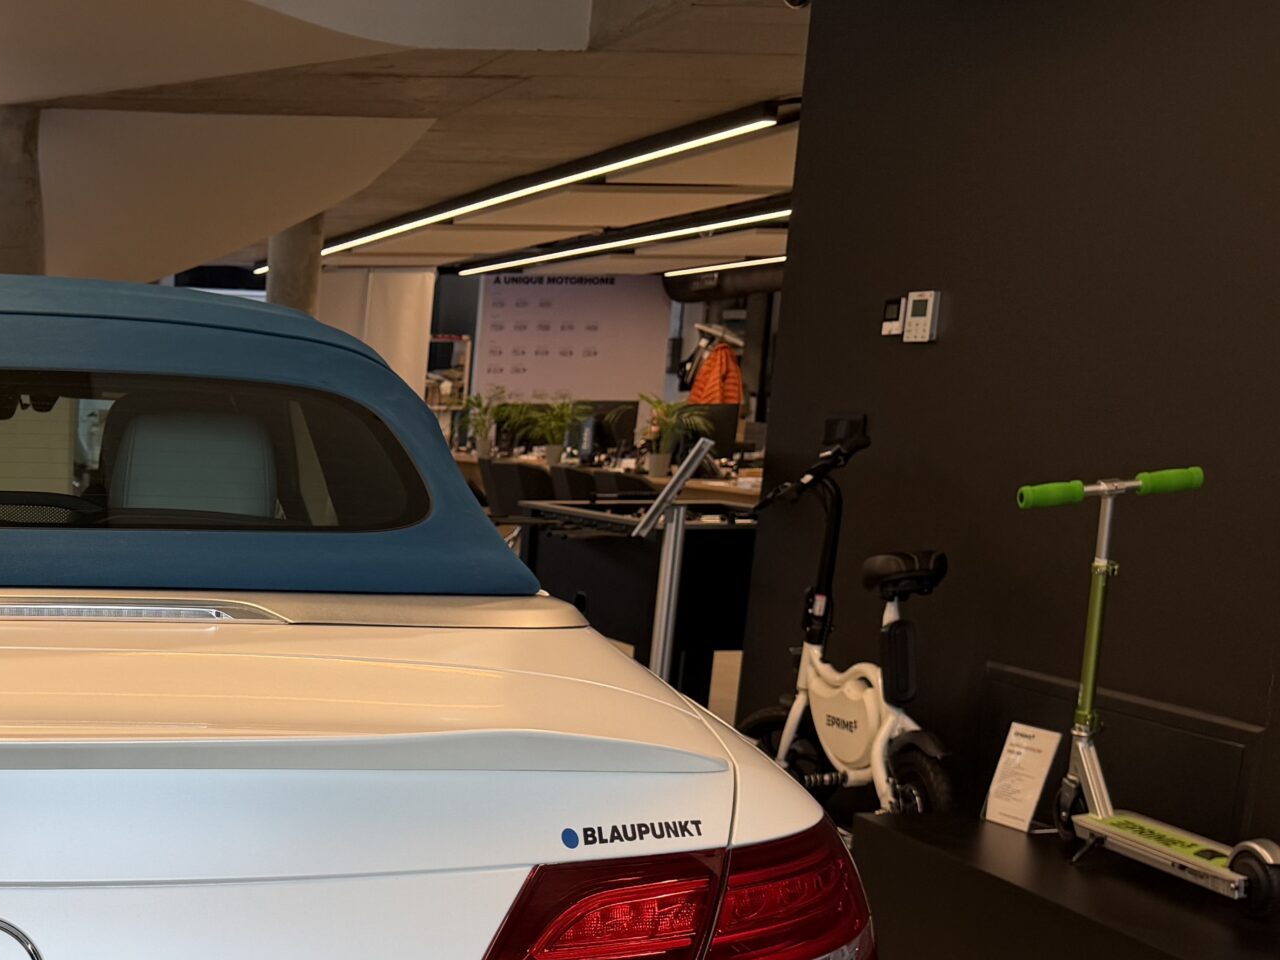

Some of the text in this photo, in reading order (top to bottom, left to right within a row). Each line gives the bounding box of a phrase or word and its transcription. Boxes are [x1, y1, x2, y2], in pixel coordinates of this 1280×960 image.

[493, 276, 616, 286] A UNIQUE MOTORHOME
[582, 819, 703, 846] BLAUPUNKT
